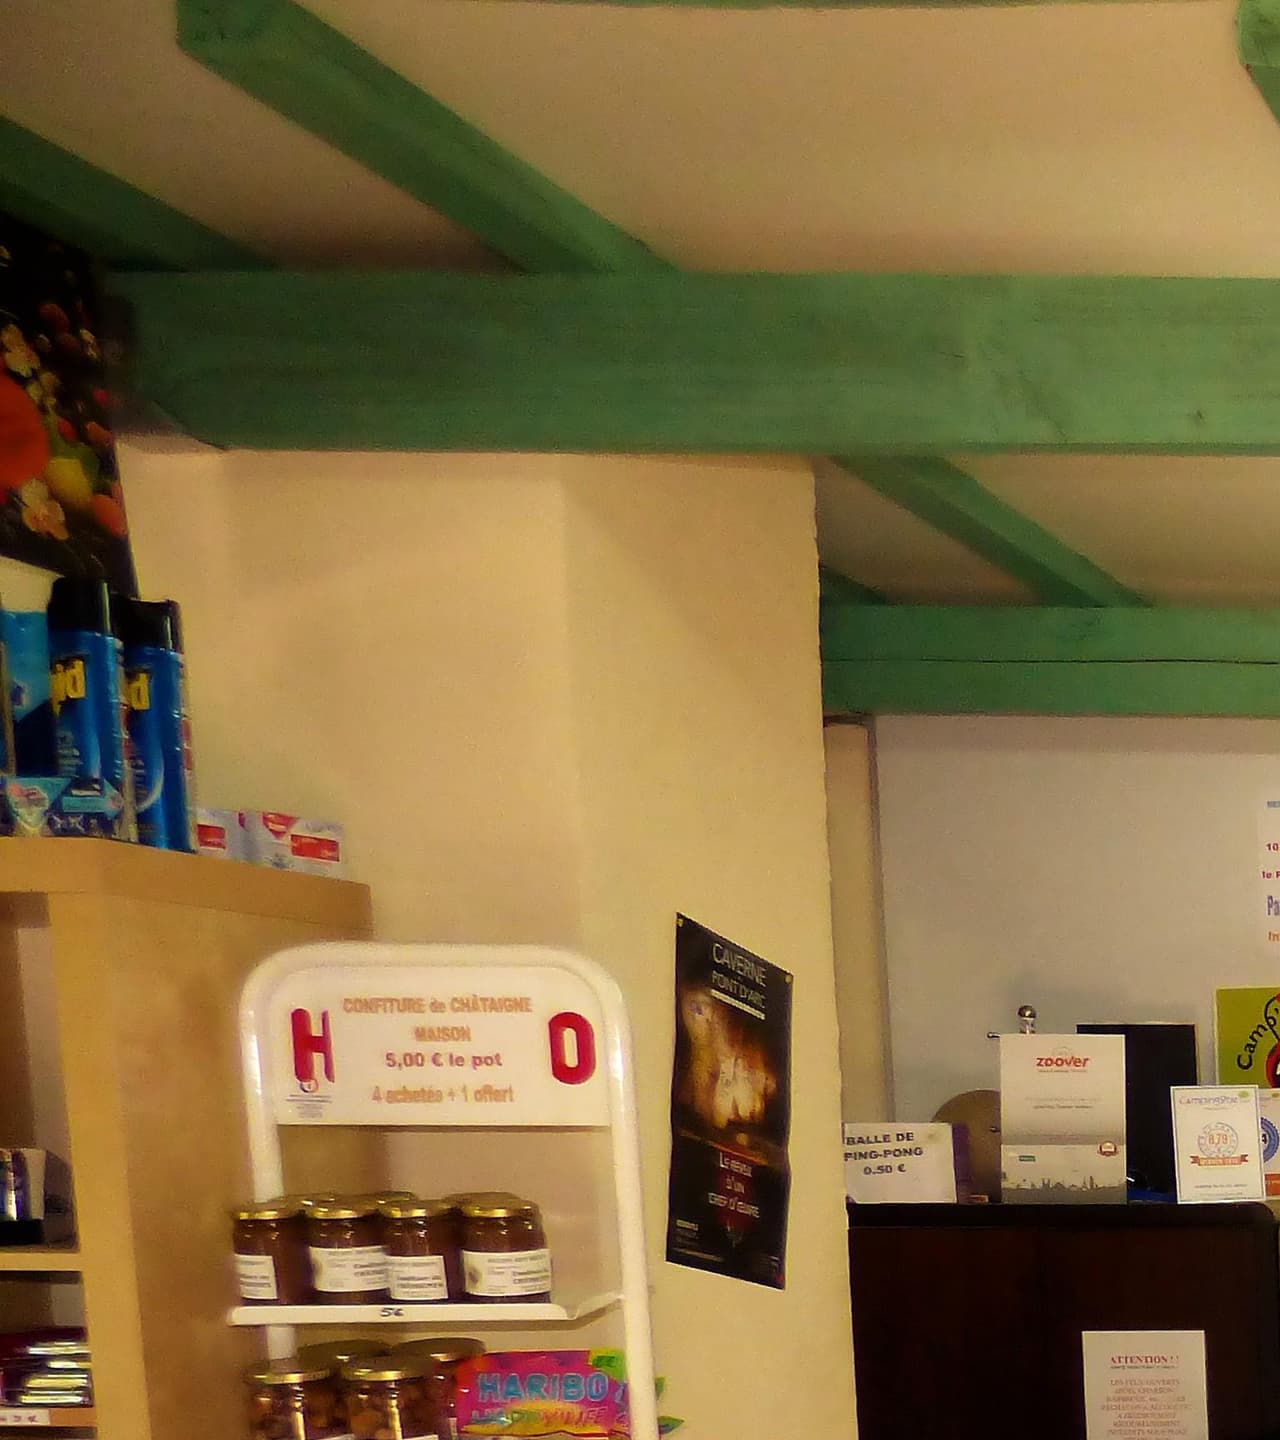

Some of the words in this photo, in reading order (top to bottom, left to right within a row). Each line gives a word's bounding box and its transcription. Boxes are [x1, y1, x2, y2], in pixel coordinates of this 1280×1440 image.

[1266, 843, 1279, 851] 10
[1262, 870, 1272, 879] le
[713, 944, 767, 988] CAVERNE
[343, 998, 424, 1013] CONFITURE
[430, 998, 446, 1013] de
[415, 1026, 471, 1042] MAISON
[386, 1053, 424, 1070] 5,00
[431, 1053, 443, 1067] €
[450, 1053, 465, 1067] le
[472, 1053, 503, 1070] pot
[1036, 1055, 1090, 1068] zoover
[846, 1133, 891, 1145] BALLE
[896, 1131, 914, 1142] DE
[844, 1146, 924, 1161] PING-PONG
[478, 1371, 609, 1402] HARIBO
